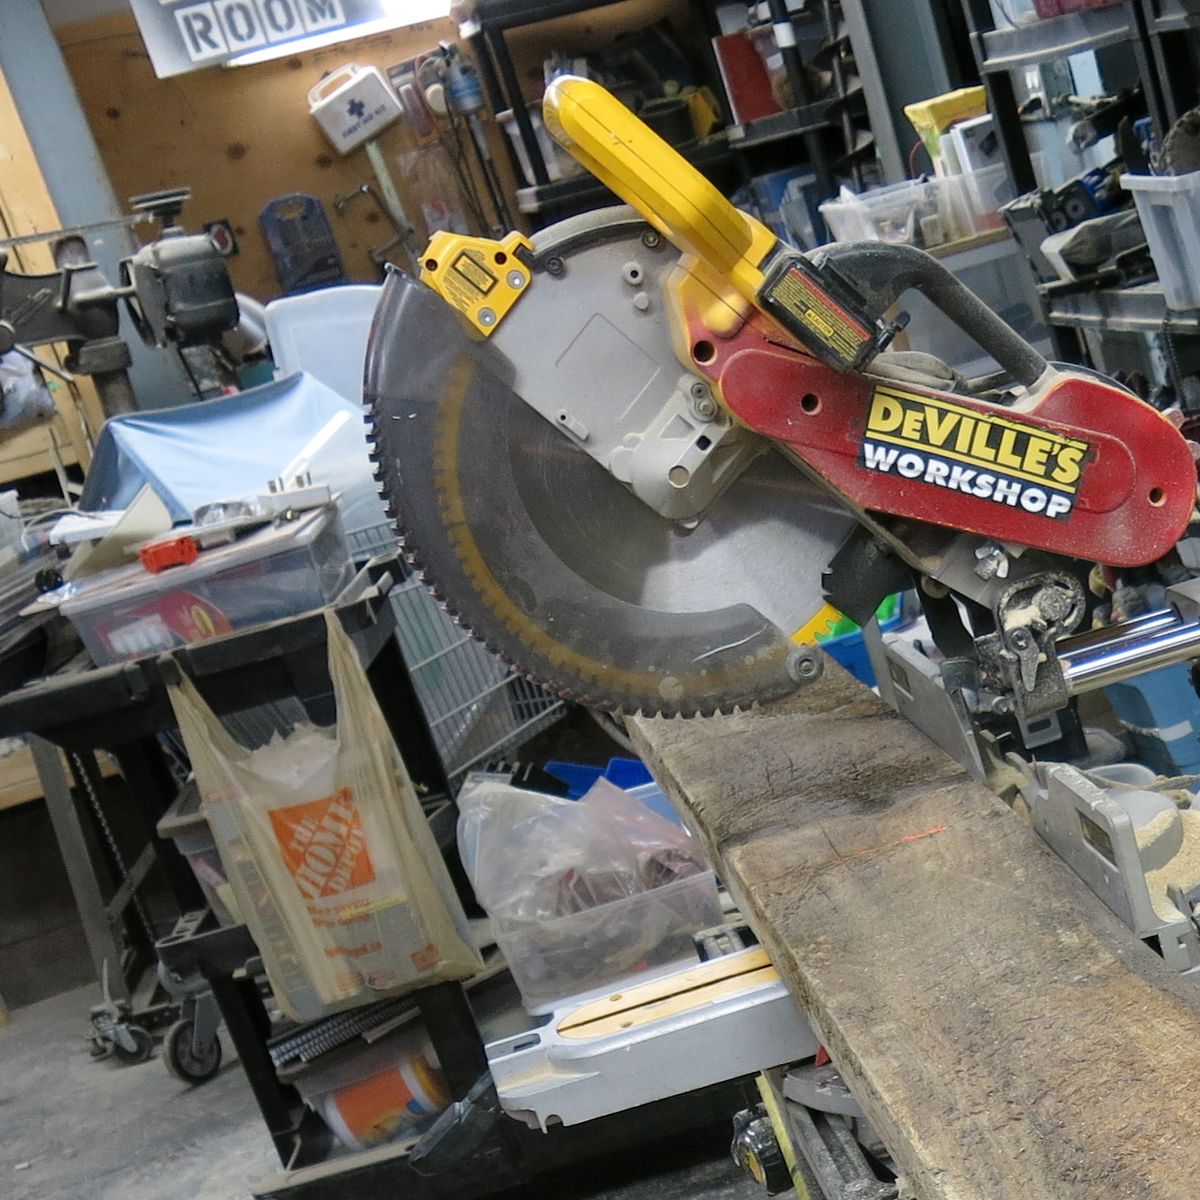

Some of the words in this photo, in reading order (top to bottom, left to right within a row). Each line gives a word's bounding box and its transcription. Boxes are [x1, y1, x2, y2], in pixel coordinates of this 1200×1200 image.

[183, 0, 338, 53] ROOM
[862, 443, 1072, 519] WORKSHOP
[288, 816, 319, 852] THE
